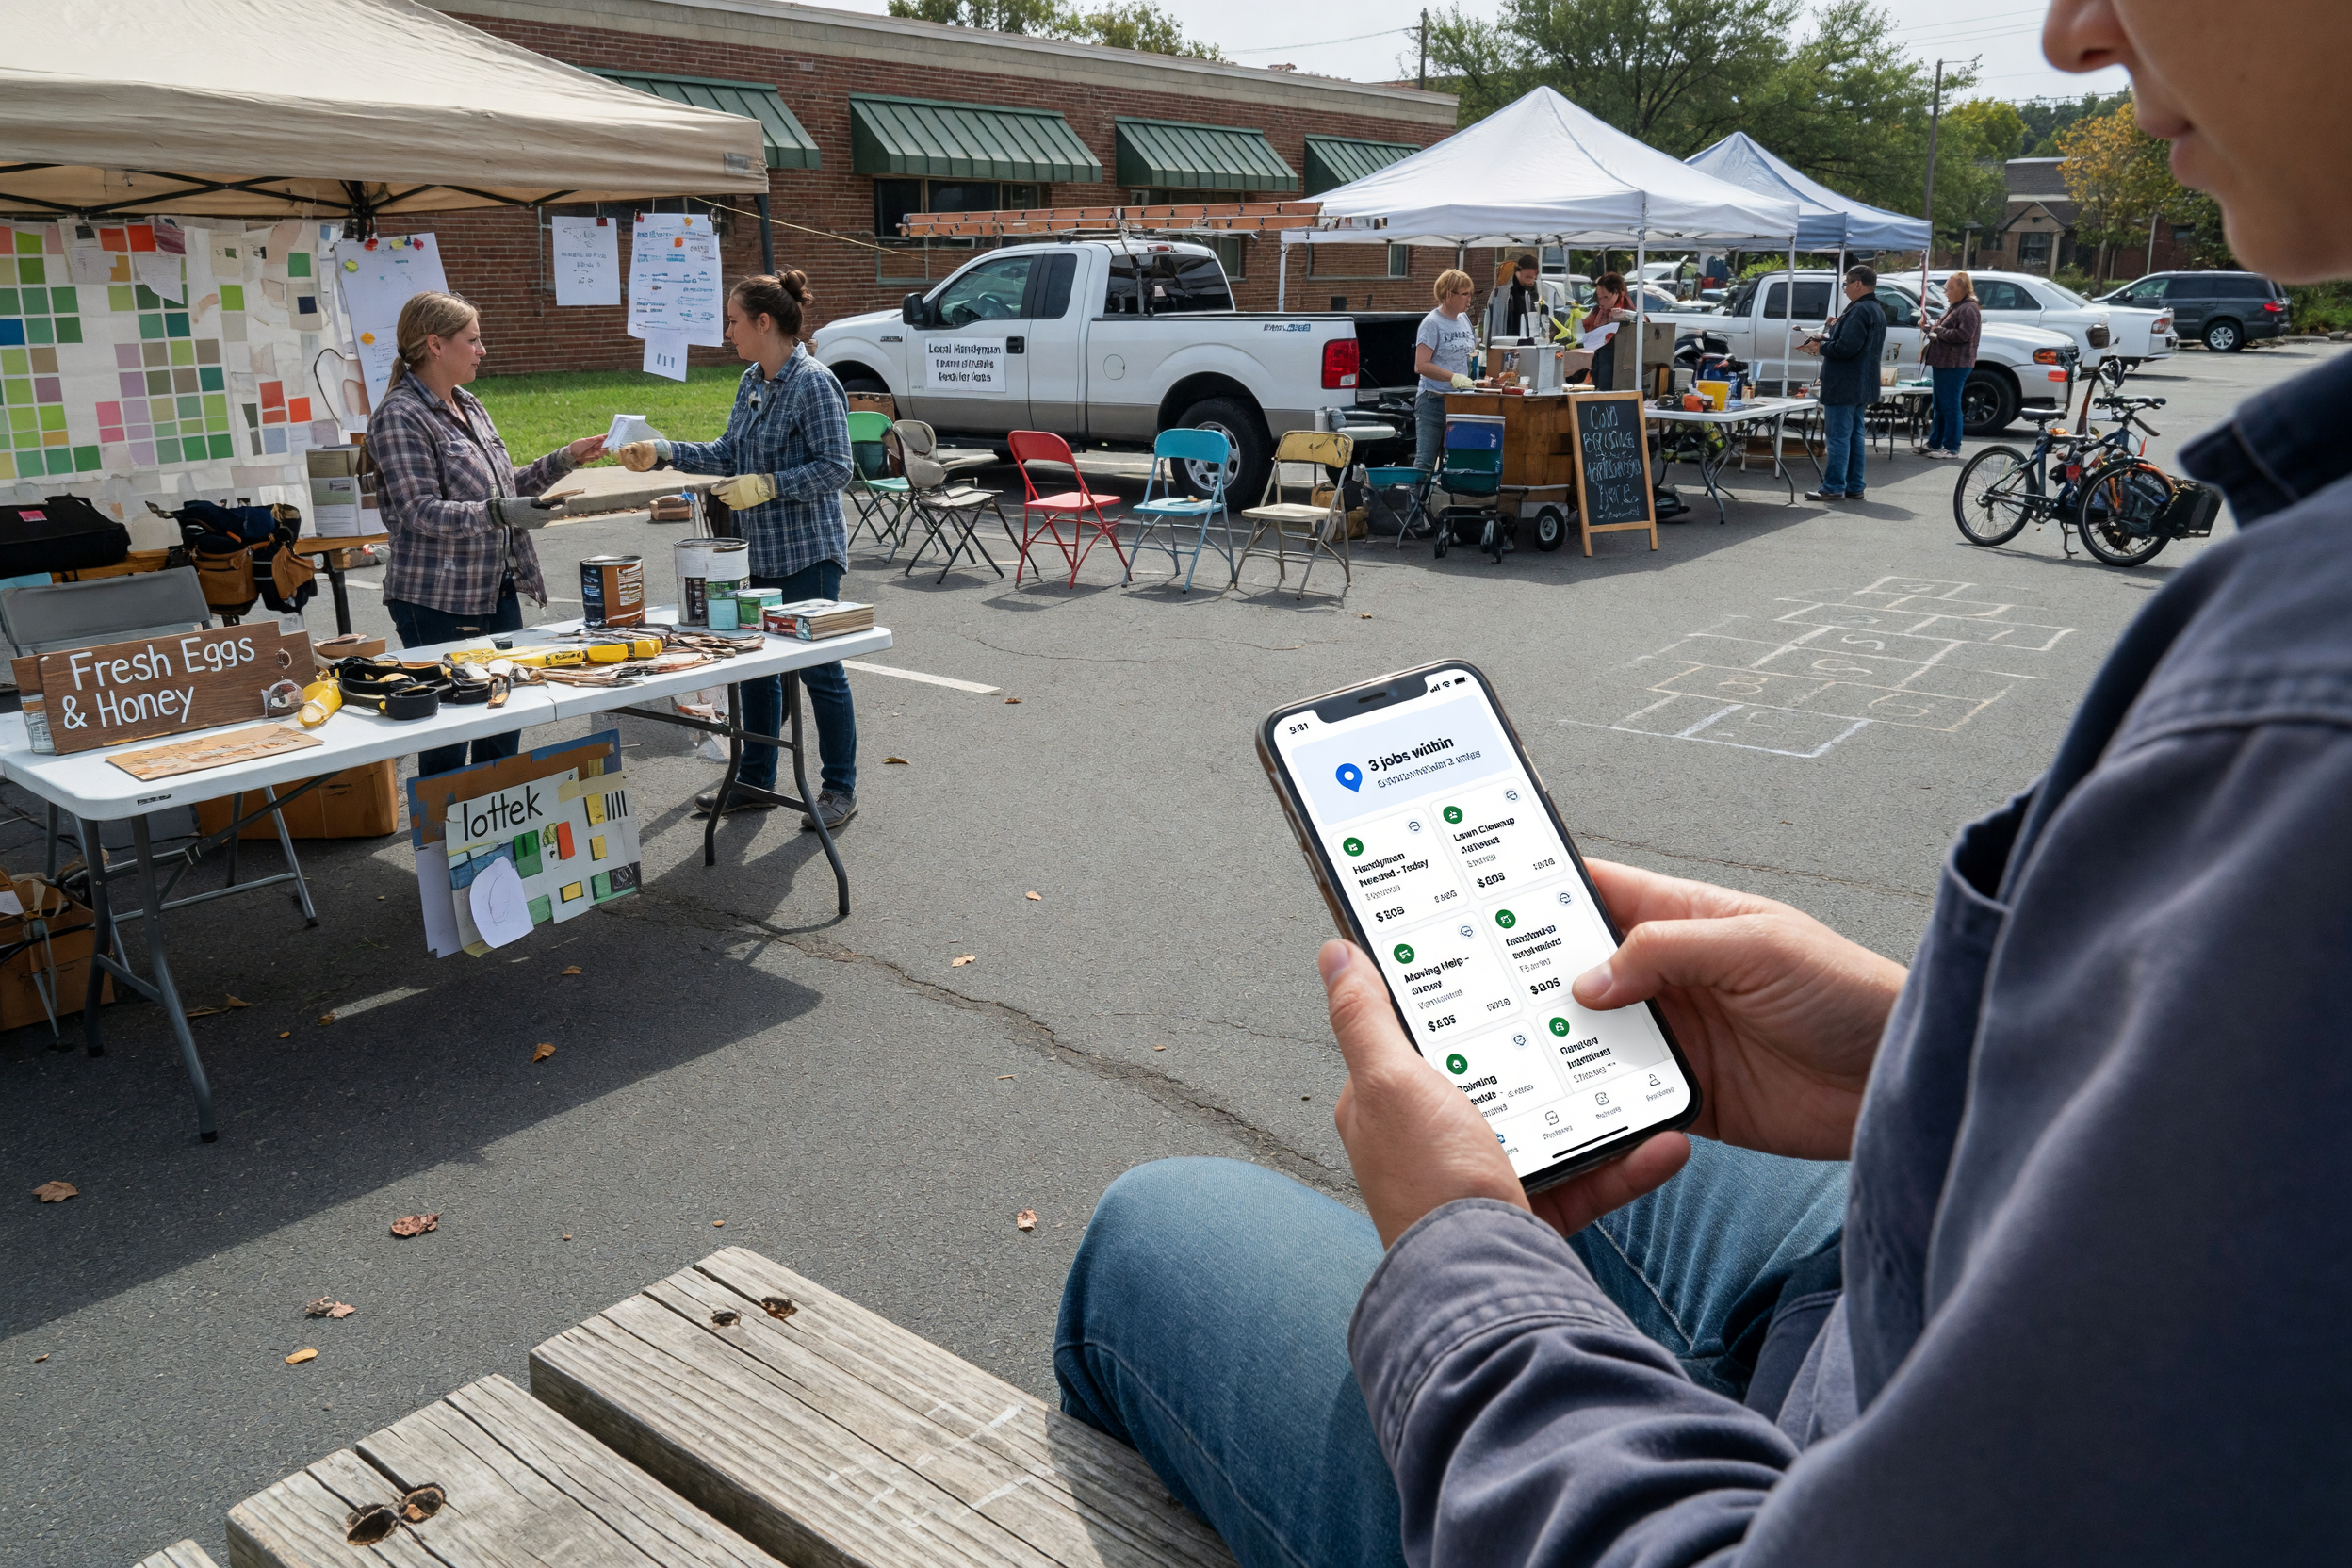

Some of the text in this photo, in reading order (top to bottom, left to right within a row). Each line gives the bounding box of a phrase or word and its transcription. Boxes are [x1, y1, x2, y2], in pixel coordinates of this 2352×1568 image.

[69, 636, 255, 691] Fresh Eggs
[62, 686, 194, 730] & Honey
[1368, 759, 1380, 772] 3
[1380, 752, 1411, 772] jobs
